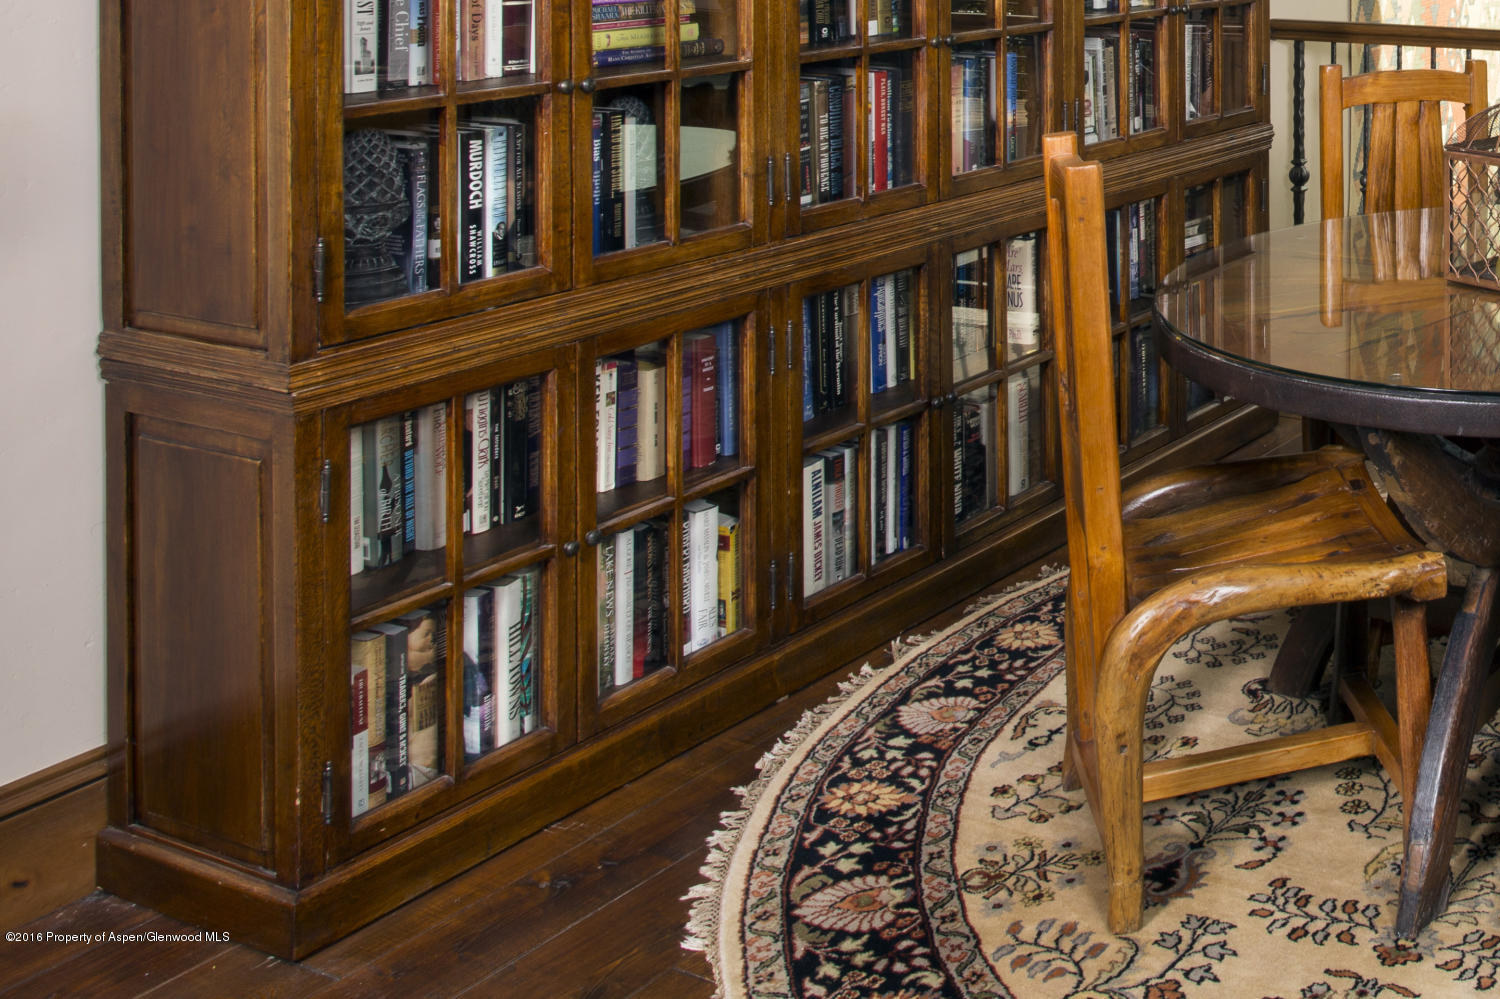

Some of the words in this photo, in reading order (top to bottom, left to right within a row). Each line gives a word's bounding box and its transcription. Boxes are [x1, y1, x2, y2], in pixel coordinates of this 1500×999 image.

[395, 10, 410, 52] Chief
[470, 13, 482, 42] Days
[820, 113, 828, 124] TO
[820, 142, 829, 151] IN
[468, 139, 482, 209] MURDOCH
[820, 152, 830, 192] PROVENCE
[416, 174, 426, 208] FLAGS
[415, 224, 426, 274] FATHERS
[468, 224, 476, 275] SHAWCROSS
[1007, 291, 1024, 308] NUS
[478, 439, 489, 470] Clark
[812, 468, 822, 520] ALNILAM
[814, 520, 822, 550] JAMES
[814, 550, 822, 582] DICKEY
